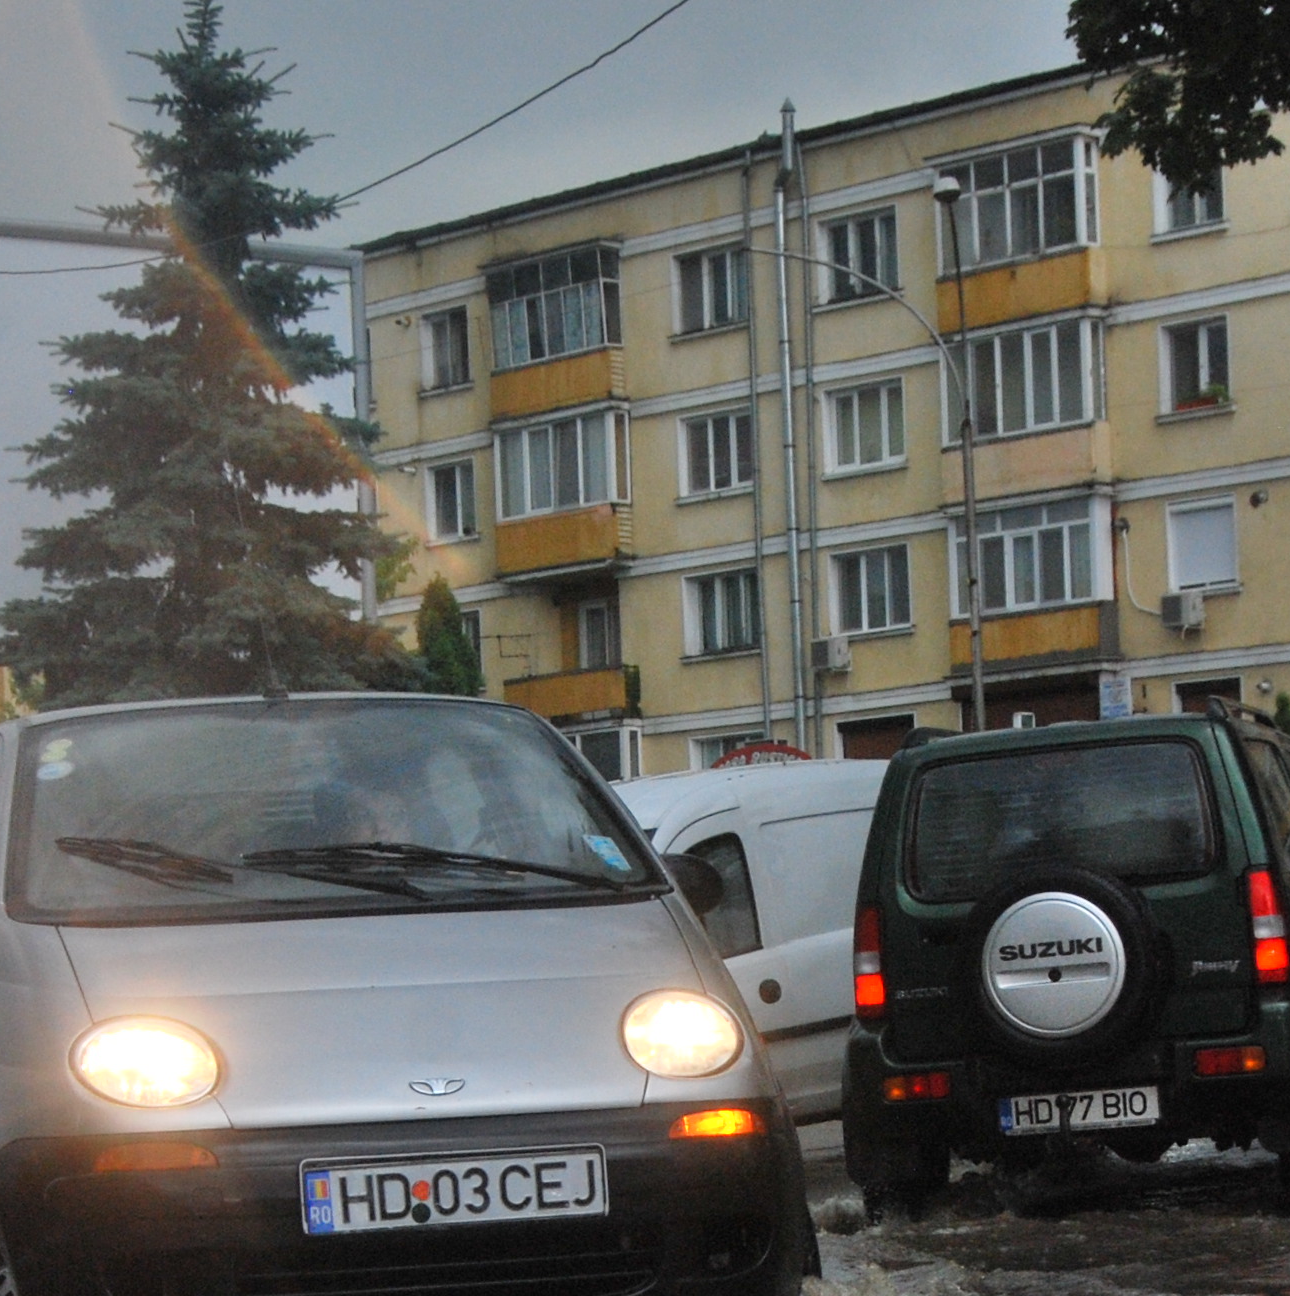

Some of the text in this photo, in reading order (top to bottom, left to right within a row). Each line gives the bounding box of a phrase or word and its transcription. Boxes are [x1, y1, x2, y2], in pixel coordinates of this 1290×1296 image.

[999, 937, 1103, 961] SUZUKI
[1014, 1099, 1053, 1126] HD
[1102, 1091, 1147, 1118] BIO
[339, 1159, 596, 1224] HD 03 CEJ
[310, 1206, 331, 1224] RO
